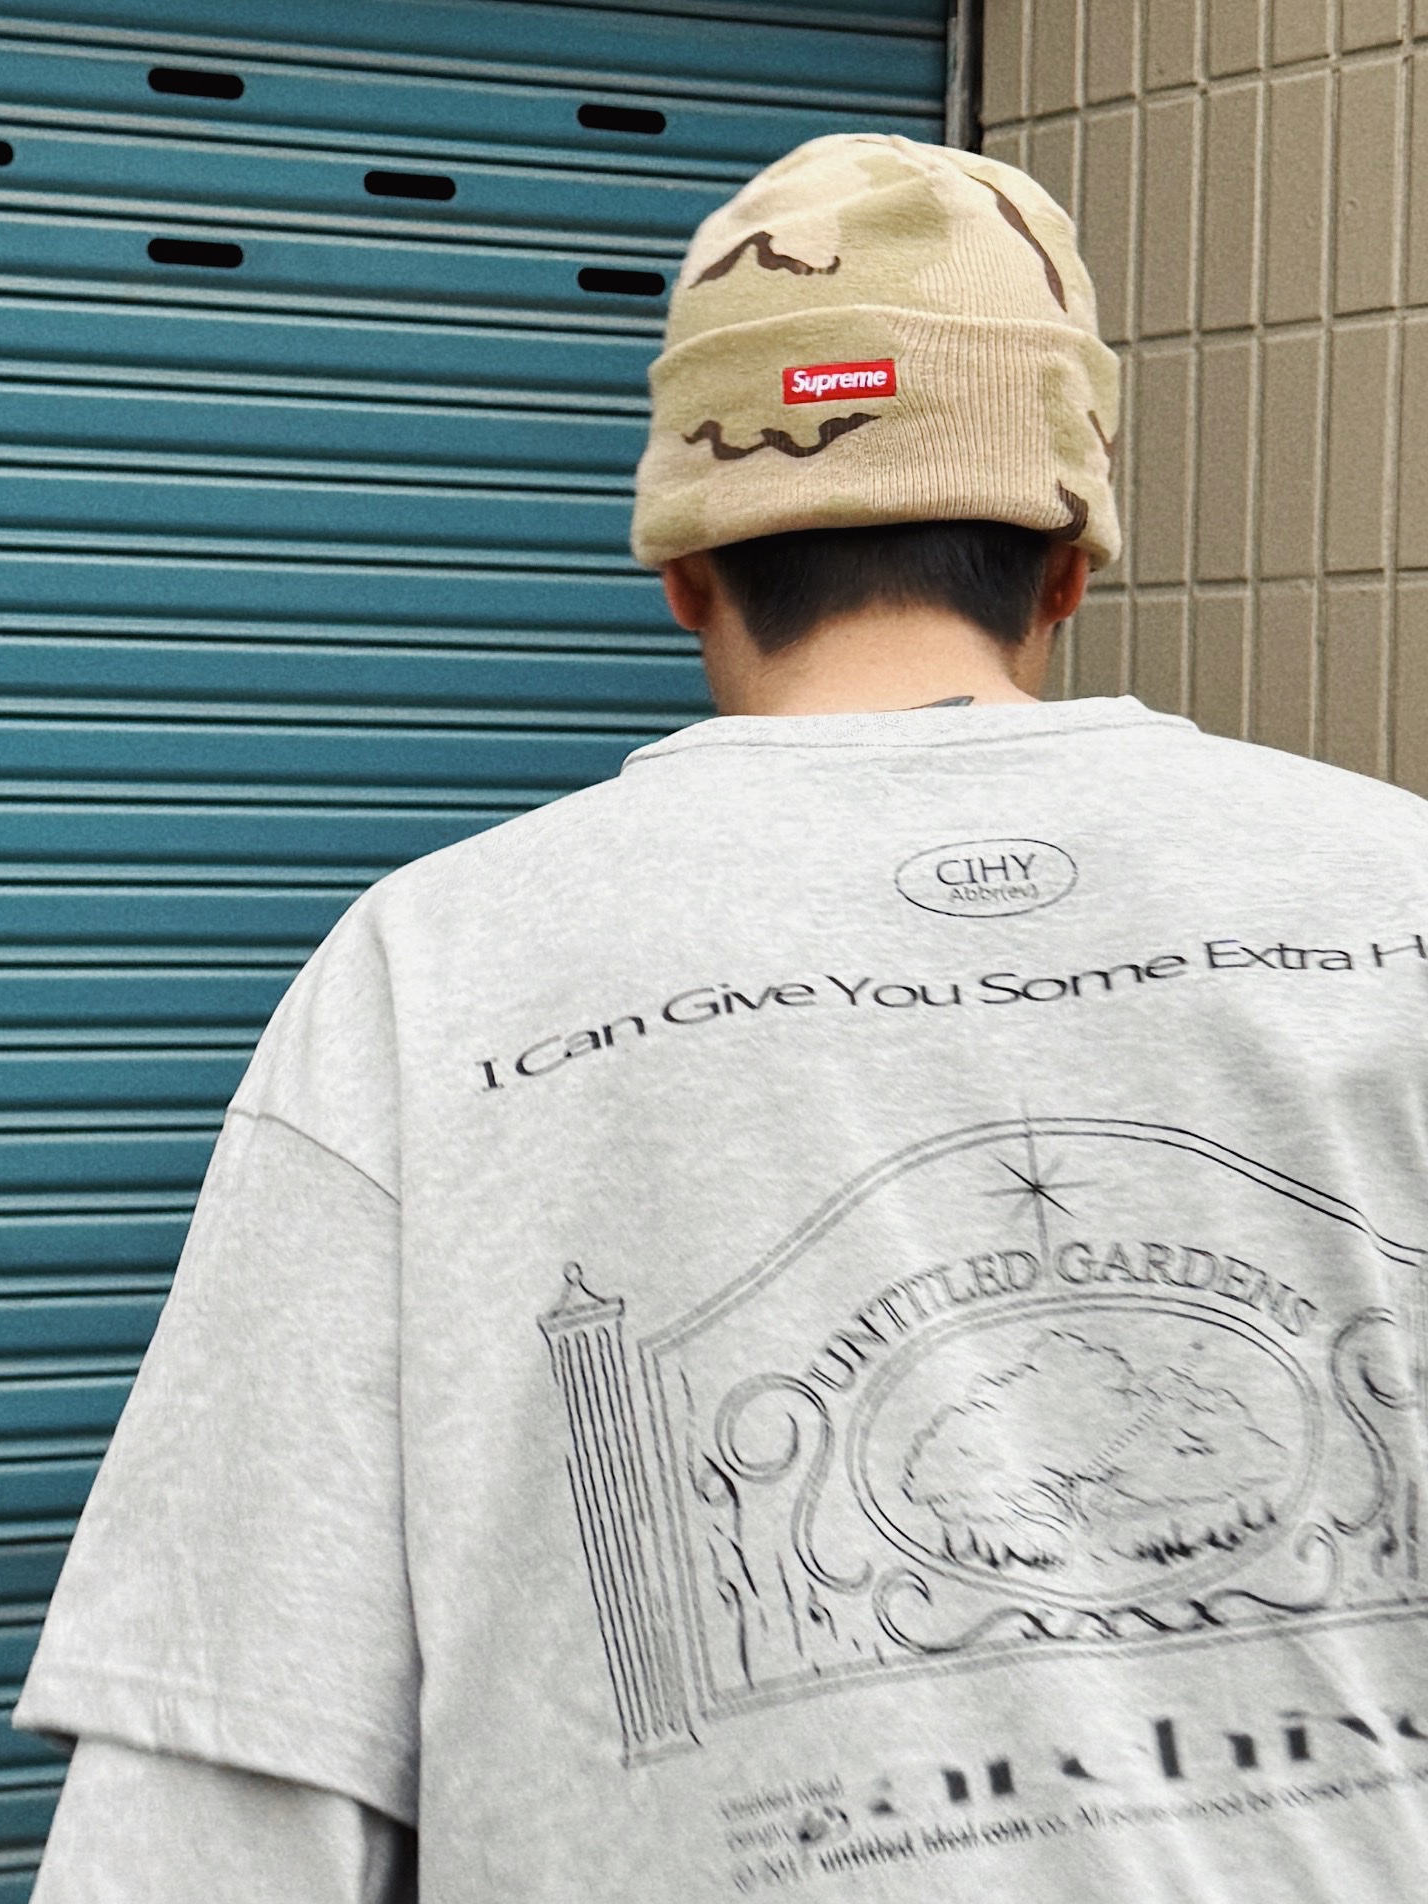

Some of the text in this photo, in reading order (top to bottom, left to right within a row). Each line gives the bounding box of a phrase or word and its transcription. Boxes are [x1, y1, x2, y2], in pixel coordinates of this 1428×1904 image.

[791, 370, 888, 397] Supreme
[936, 853, 1036, 886] CIHY
[475, 1057, 504, 1093] I
[515, 1015, 646, 1078] Can
[662, 982, 815, 1025] Give
[824, 973, 962, 1009] You
[978, 954, 1190, 1005] Some
[1202, 938, 1355, 972] Extra
[809, 1241, 1319, 1393] UNTITLED GARDENS
